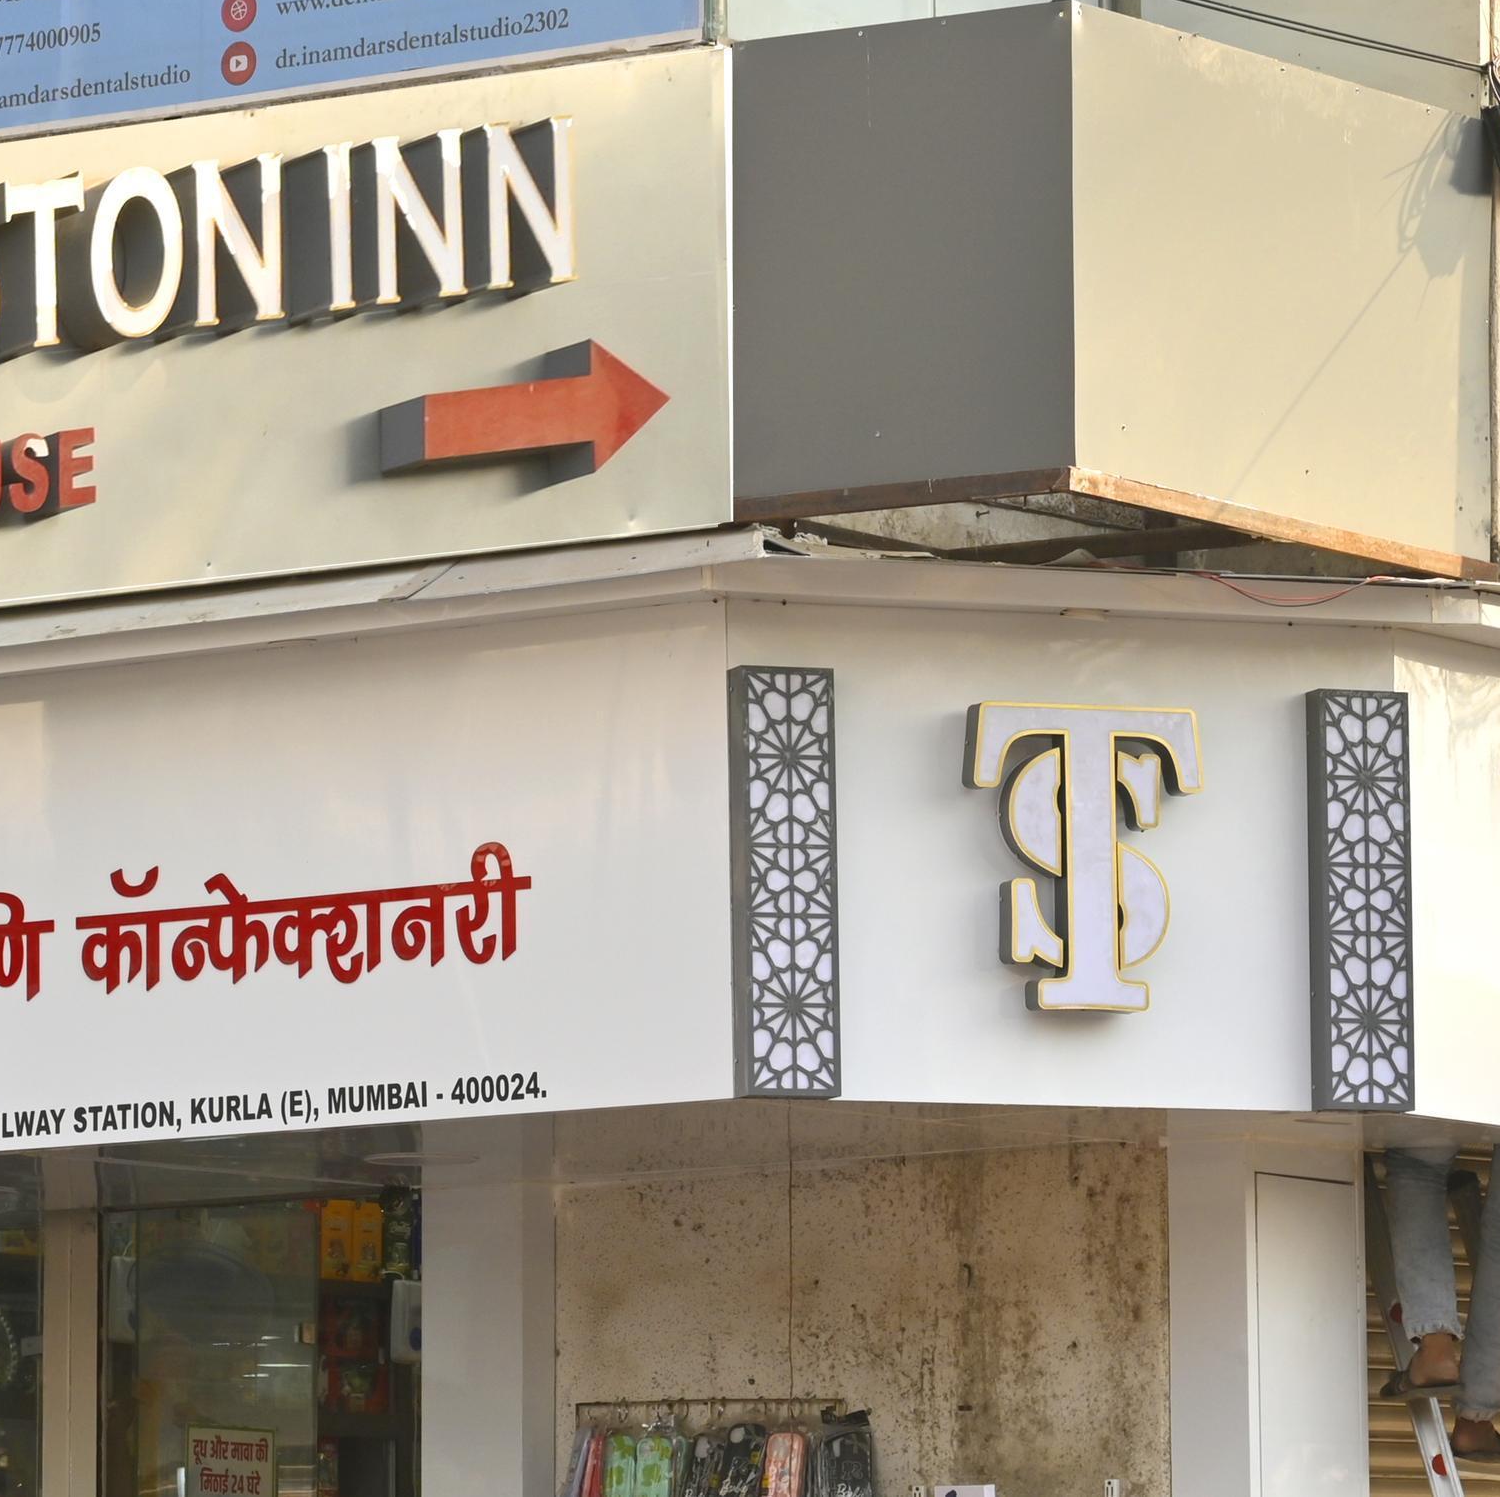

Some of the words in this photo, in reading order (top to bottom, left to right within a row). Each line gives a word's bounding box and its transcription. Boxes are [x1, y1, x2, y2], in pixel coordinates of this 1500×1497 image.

[275, 8, 571, 71] dr.inamdarsdentalstudio2302
[326, 116, 578, 315] INN
[73, 1099, 183, 1135] STATION,
[190, 1092, 273, 1126] KURLA
[280, 1088, 320, 1124] (E),
[327, 1081, 428, 1115] MUMBAI
[450, 1071, 547, 1105] 400024.
[193, 1439, 208, 1464] दूध
[210, 1435, 230, 1460] और
[231, 1441, 254, 1462] मावा
[255, 1438, 268, 1462] की
[200, 1467, 229, 1495] मिठाई
[232, 1475, 244, 1493] 24
[246, 1471, 261, 1495] घंटे
